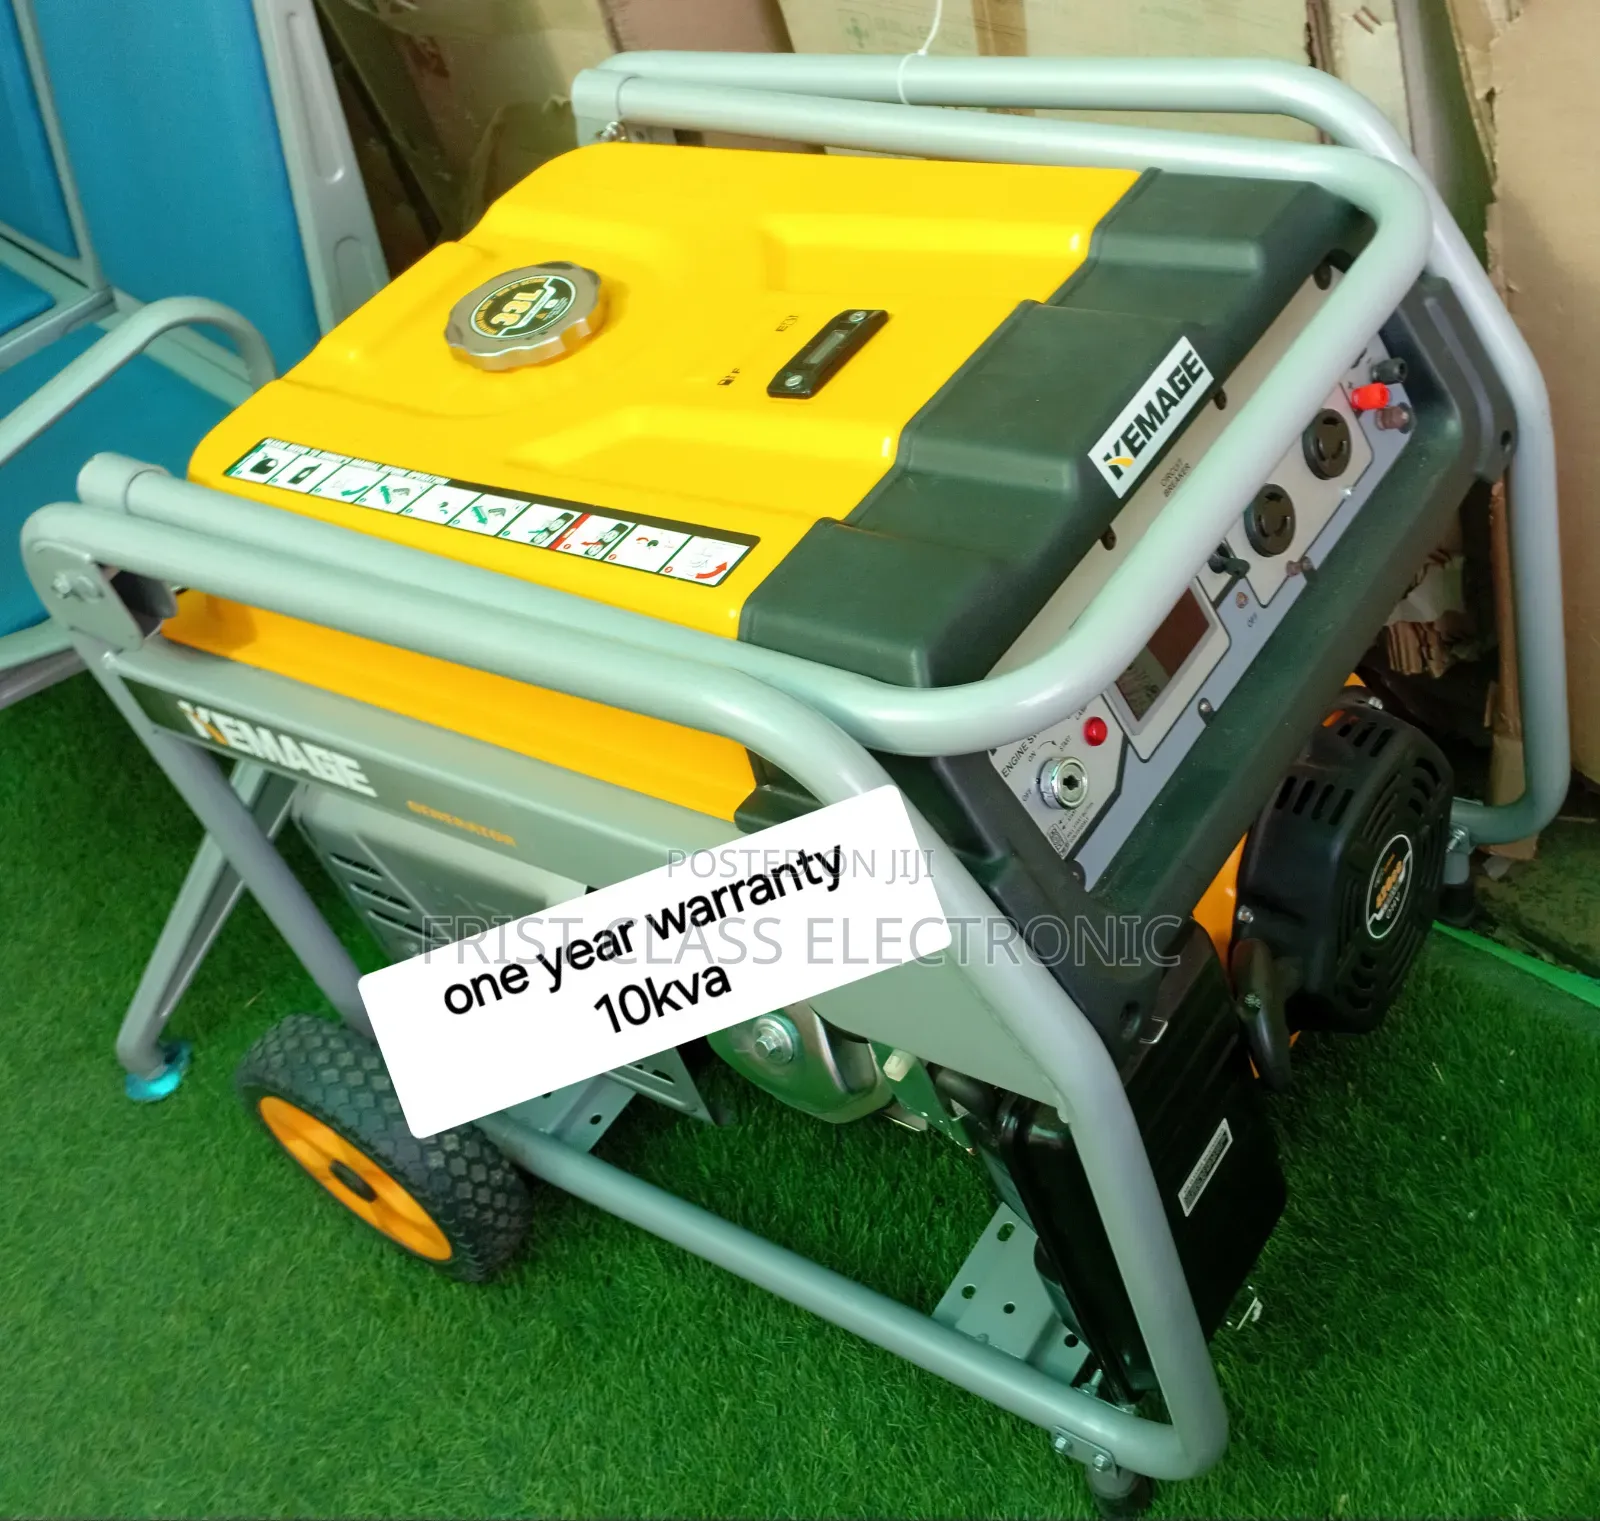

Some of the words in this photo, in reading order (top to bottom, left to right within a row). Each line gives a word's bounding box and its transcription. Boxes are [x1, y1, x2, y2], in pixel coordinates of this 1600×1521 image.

[490, 288, 545, 326] 33L
[1103, 349, 1205, 480] KEMAGE
[177, 700, 378, 798] KEMAGE
[1001, 742, 1029, 778] ENGINE
[1027, 750, 1037, 763] ON
